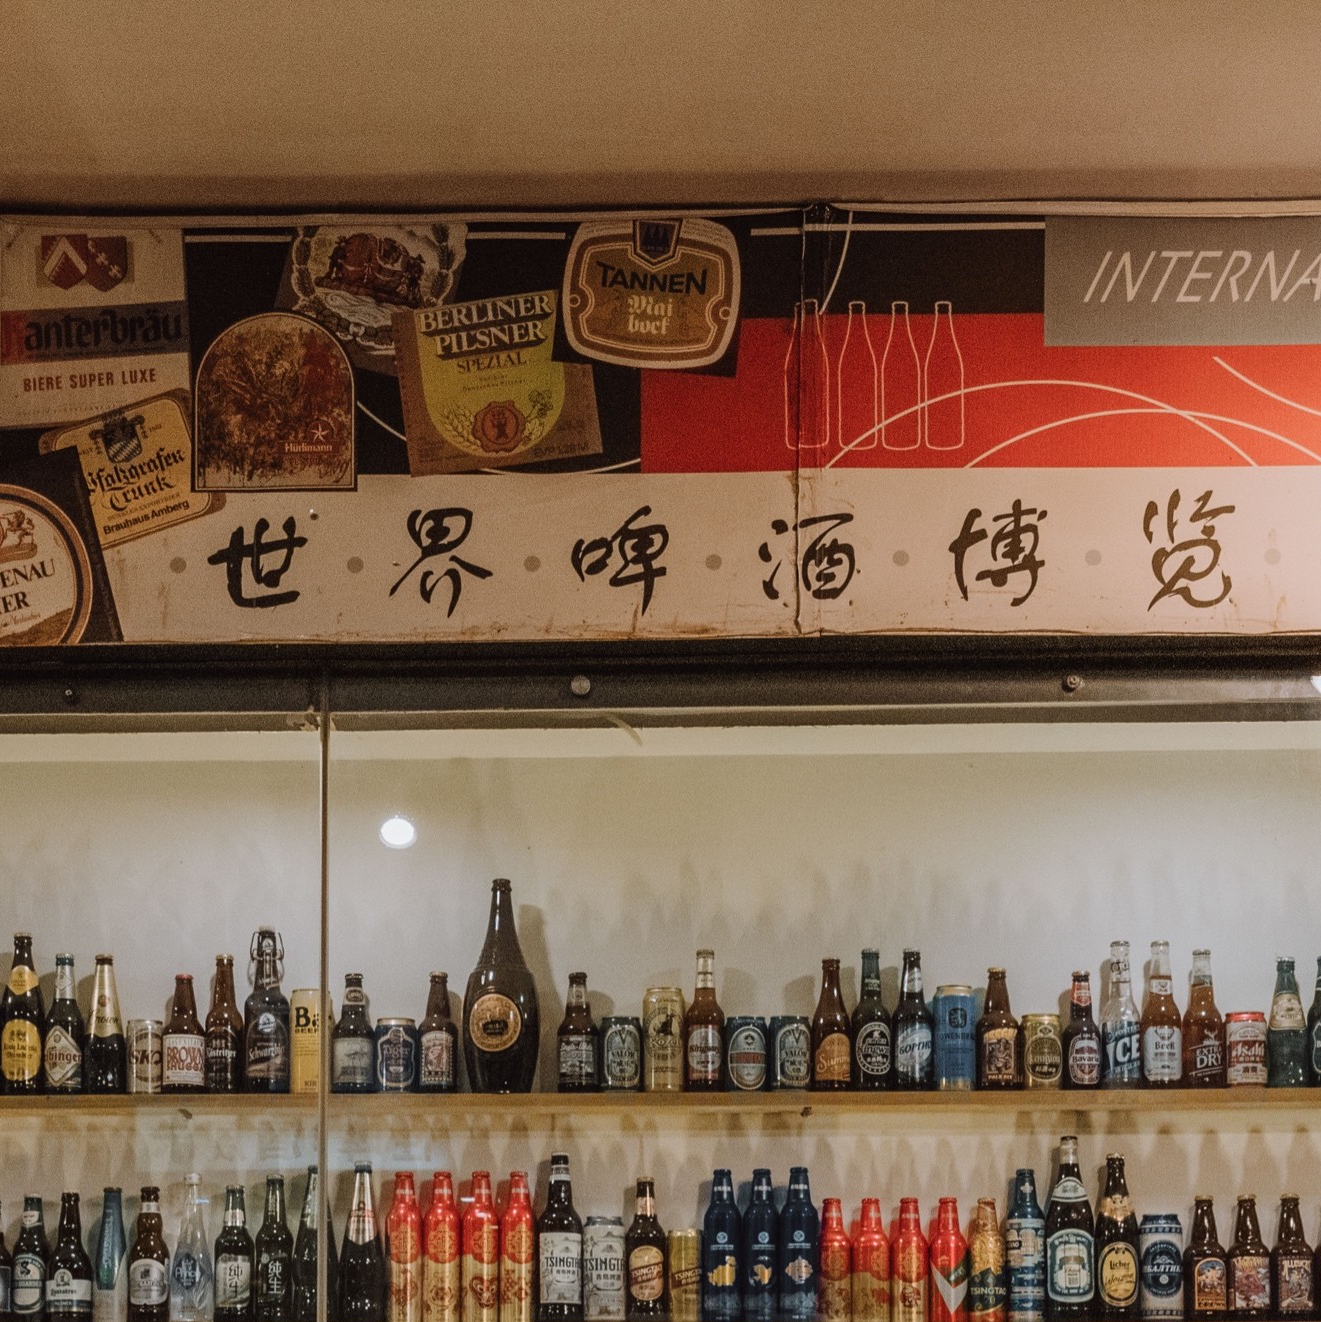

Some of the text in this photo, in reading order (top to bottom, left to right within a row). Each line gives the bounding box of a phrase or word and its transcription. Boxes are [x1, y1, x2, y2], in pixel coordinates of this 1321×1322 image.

[596, 260, 708, 295] TANNEN
[6, 307, 184, 354] anterbräu
[418, 294, 553, 334] BERLINER
[435, 320, 548, 360] PILSNER
[69, 370, 116, 390] SUPER
[121, 367, 158, 387] LUXE
[455, 352, 528, 374] SPEZIAL
[102, 510, 150, 537] Brauhaus
[148, 499, 191, 527] Amberg
[208, 487, 1235, 618] 世界啤酒博览
[1196, 1054, 1221, 1068] DRY
[1231, 1042, 1265, 1057] Asahi
